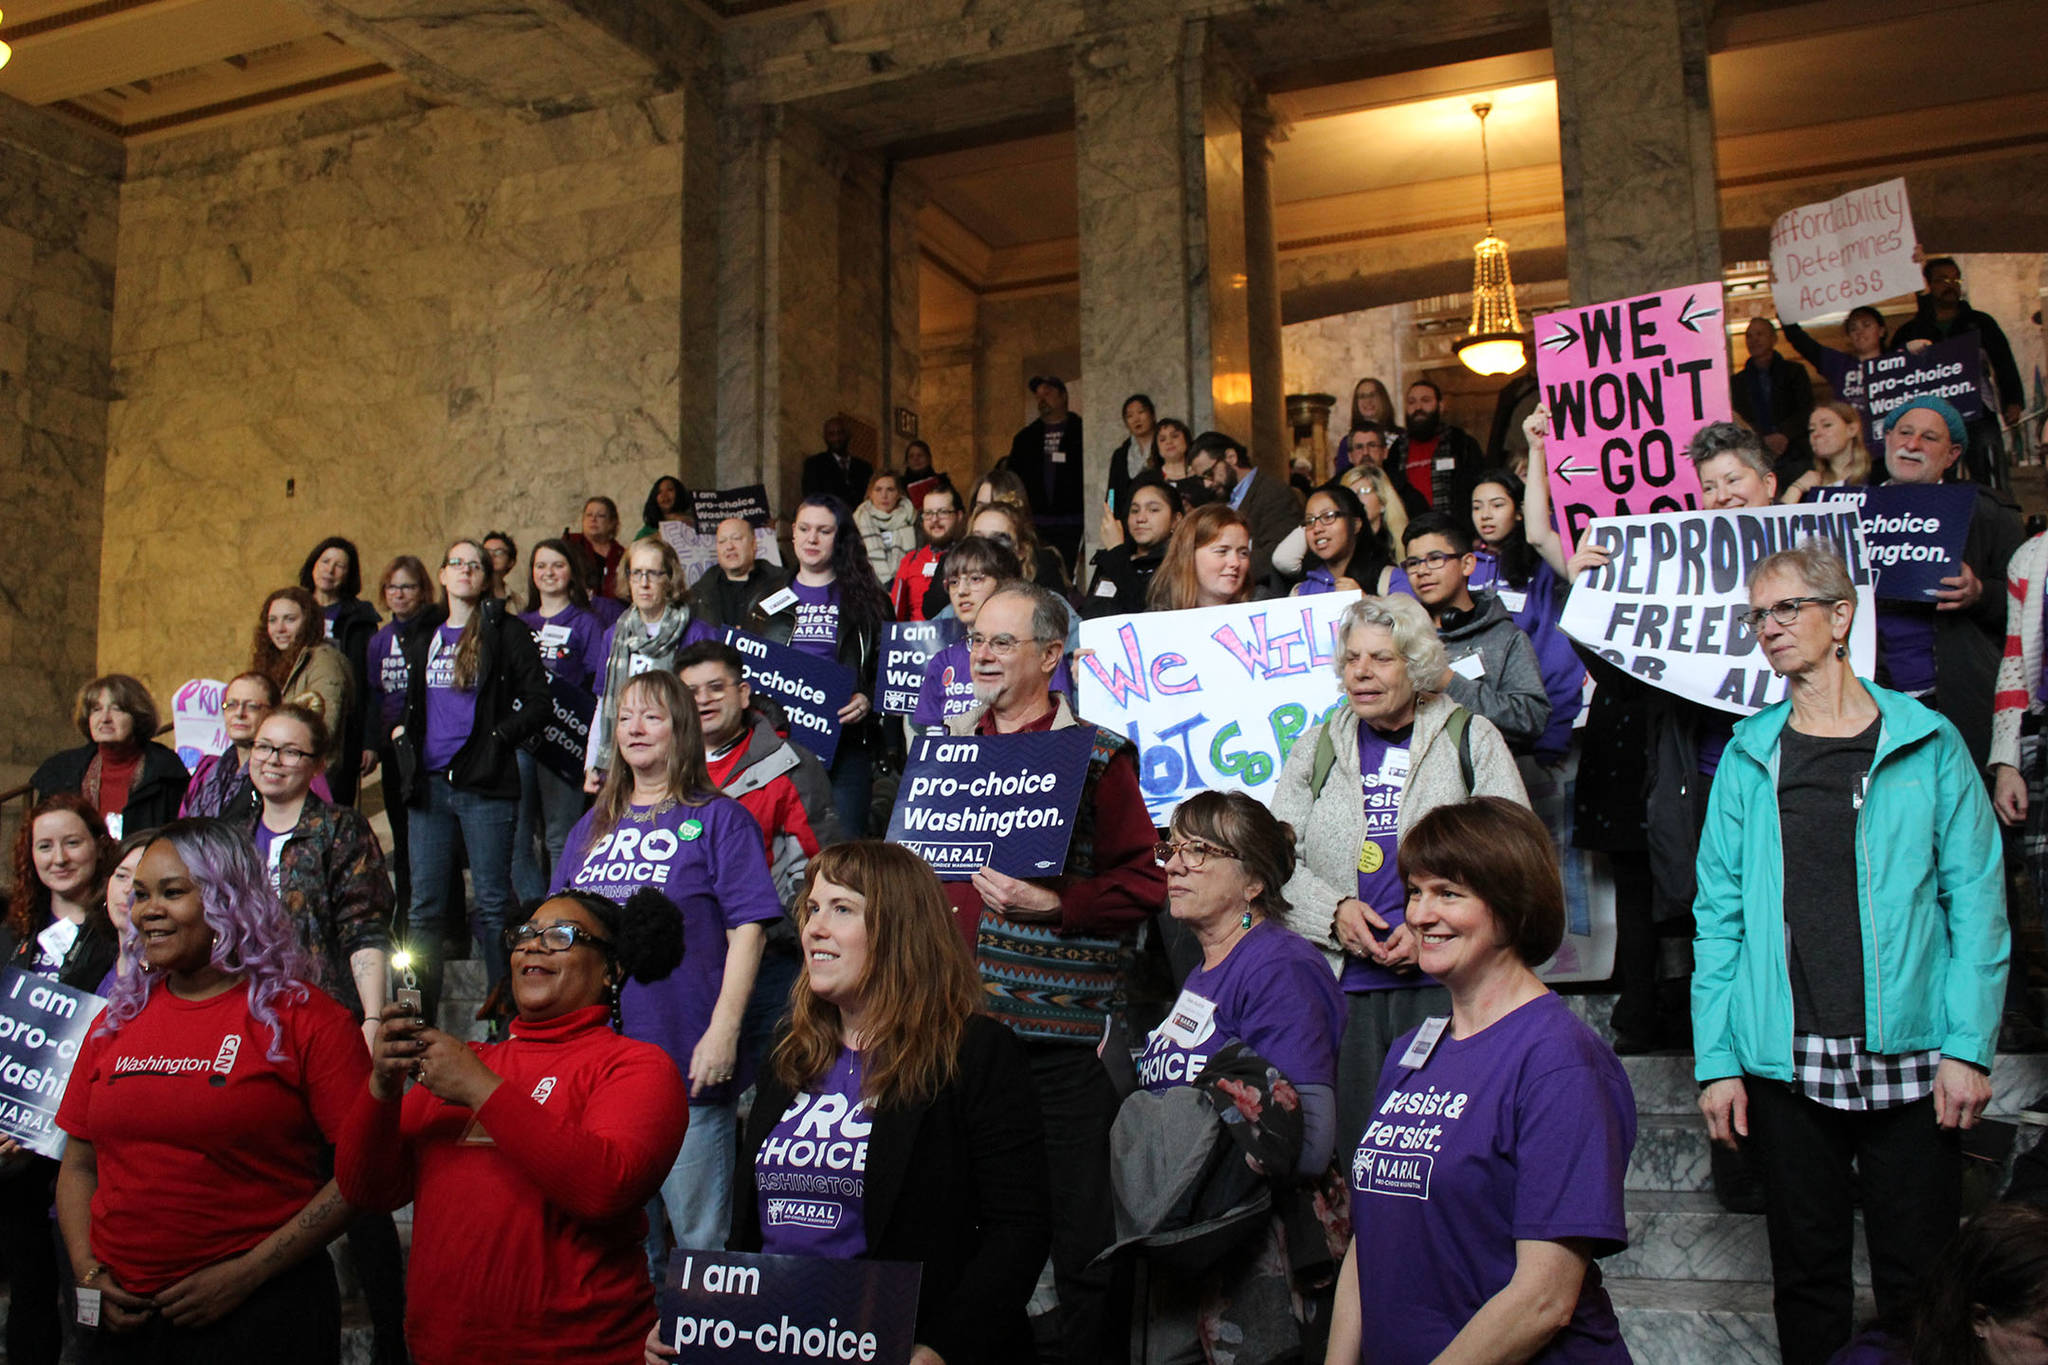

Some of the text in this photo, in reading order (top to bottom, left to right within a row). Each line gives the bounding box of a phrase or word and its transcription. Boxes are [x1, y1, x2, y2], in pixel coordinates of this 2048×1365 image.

[1786, 230, 1902, 283] Determines
[1800, 269, 1884, 311] Access
[1579, 297, 1667, 368] WE
[1868, 356, 1906, 375] I am
[1868, 362, 1962, 399] pro-choice
[1547, 358, 1713, 441] WON'T
[1601, 429, 1676, 495] GO
[695, 497, 756, 509] pro-choice
[699, 491, 718, 499] am
[697, 507, 766, 520] Washington.
[1861, 512, 1941, 534] choice
[1868, 541, 1951, 566] ington.
[724, 629, 768, 659] I am
[794, 625, 833, 635] ARAL
[891, 624, 936, 641] I am
[1604, 602, 1757, 657] FREED
[1082, 622, 1203, 709] We
[919, 739, 979, 763] I am
[1209, 720, 1274, 786] GO
[908, 768, 1057, 802] pro-choice
[904, 805, 1064, 838] Washington.
[583, 827, 678, 867] PRO
[923, 847, 984, 862] NARAL
[574, 862, 671, 884] CHOICE
[10, 975, 26, 999] I
[29, 986, 78, 1018] am
[115, 1035, 240, 1075] Washington CAN
[756, 1172, 865, 1198] ASHINGTON
[1376, 1157, 1422, 1181] NARAL
[784, 1203, 835, 1219] NARAL
[681, 1256, 760, 1296] I am
[674, 1315, 877, 1362] pro-choice
